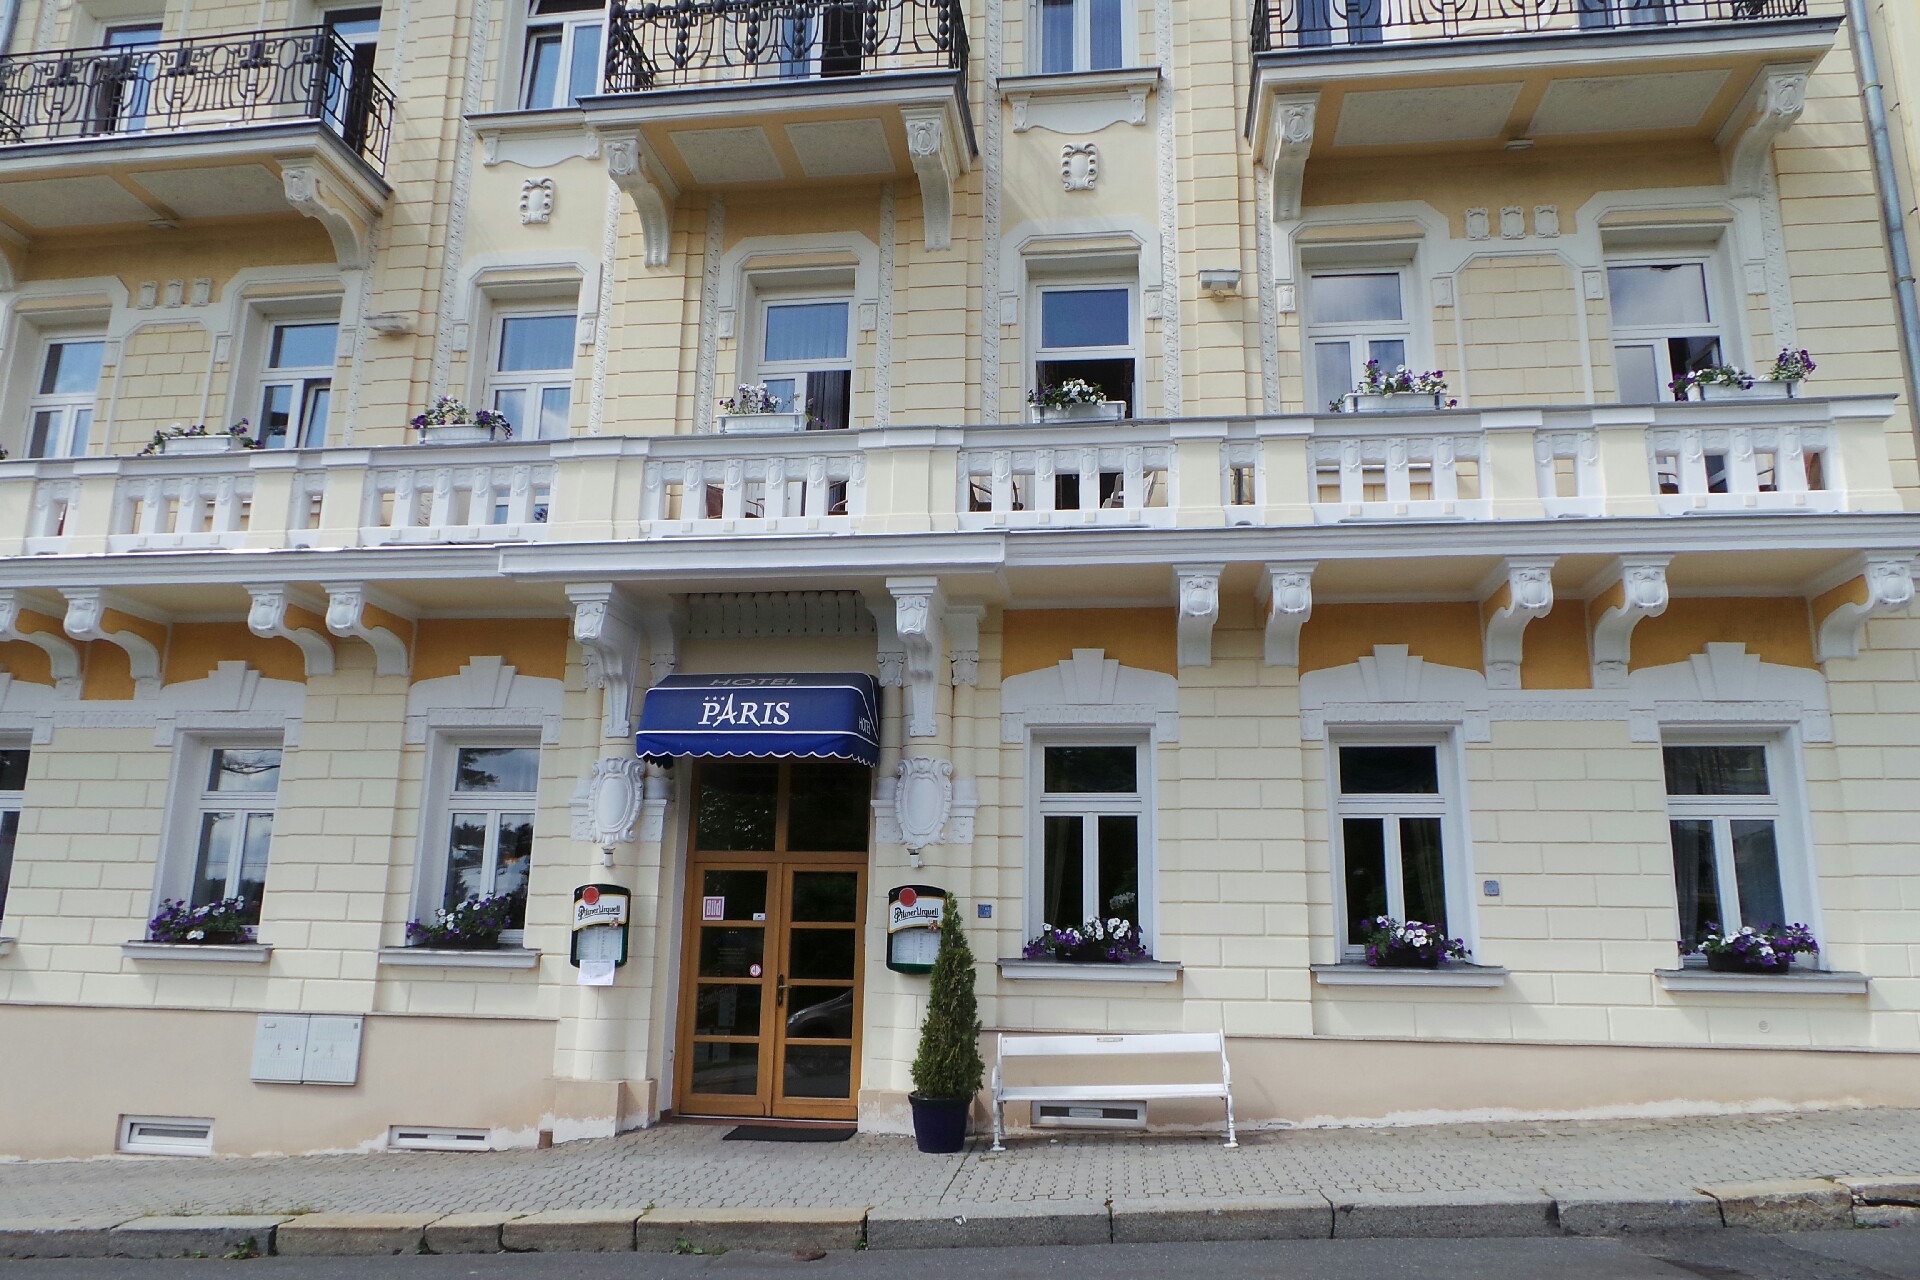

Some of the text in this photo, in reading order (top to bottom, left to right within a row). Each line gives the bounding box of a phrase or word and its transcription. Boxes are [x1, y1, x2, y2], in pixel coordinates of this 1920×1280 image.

[709, 677, 798, 686] HOTEL
[698, 693, 790, 727] PARIS
[858, 715, 871, 735] HOTEL
[578, 904, 621, 920] Pilsner Urquell
[706, 899, 721, 916] Bild
[894, 906, 939, 923] Pilsner Urquell
